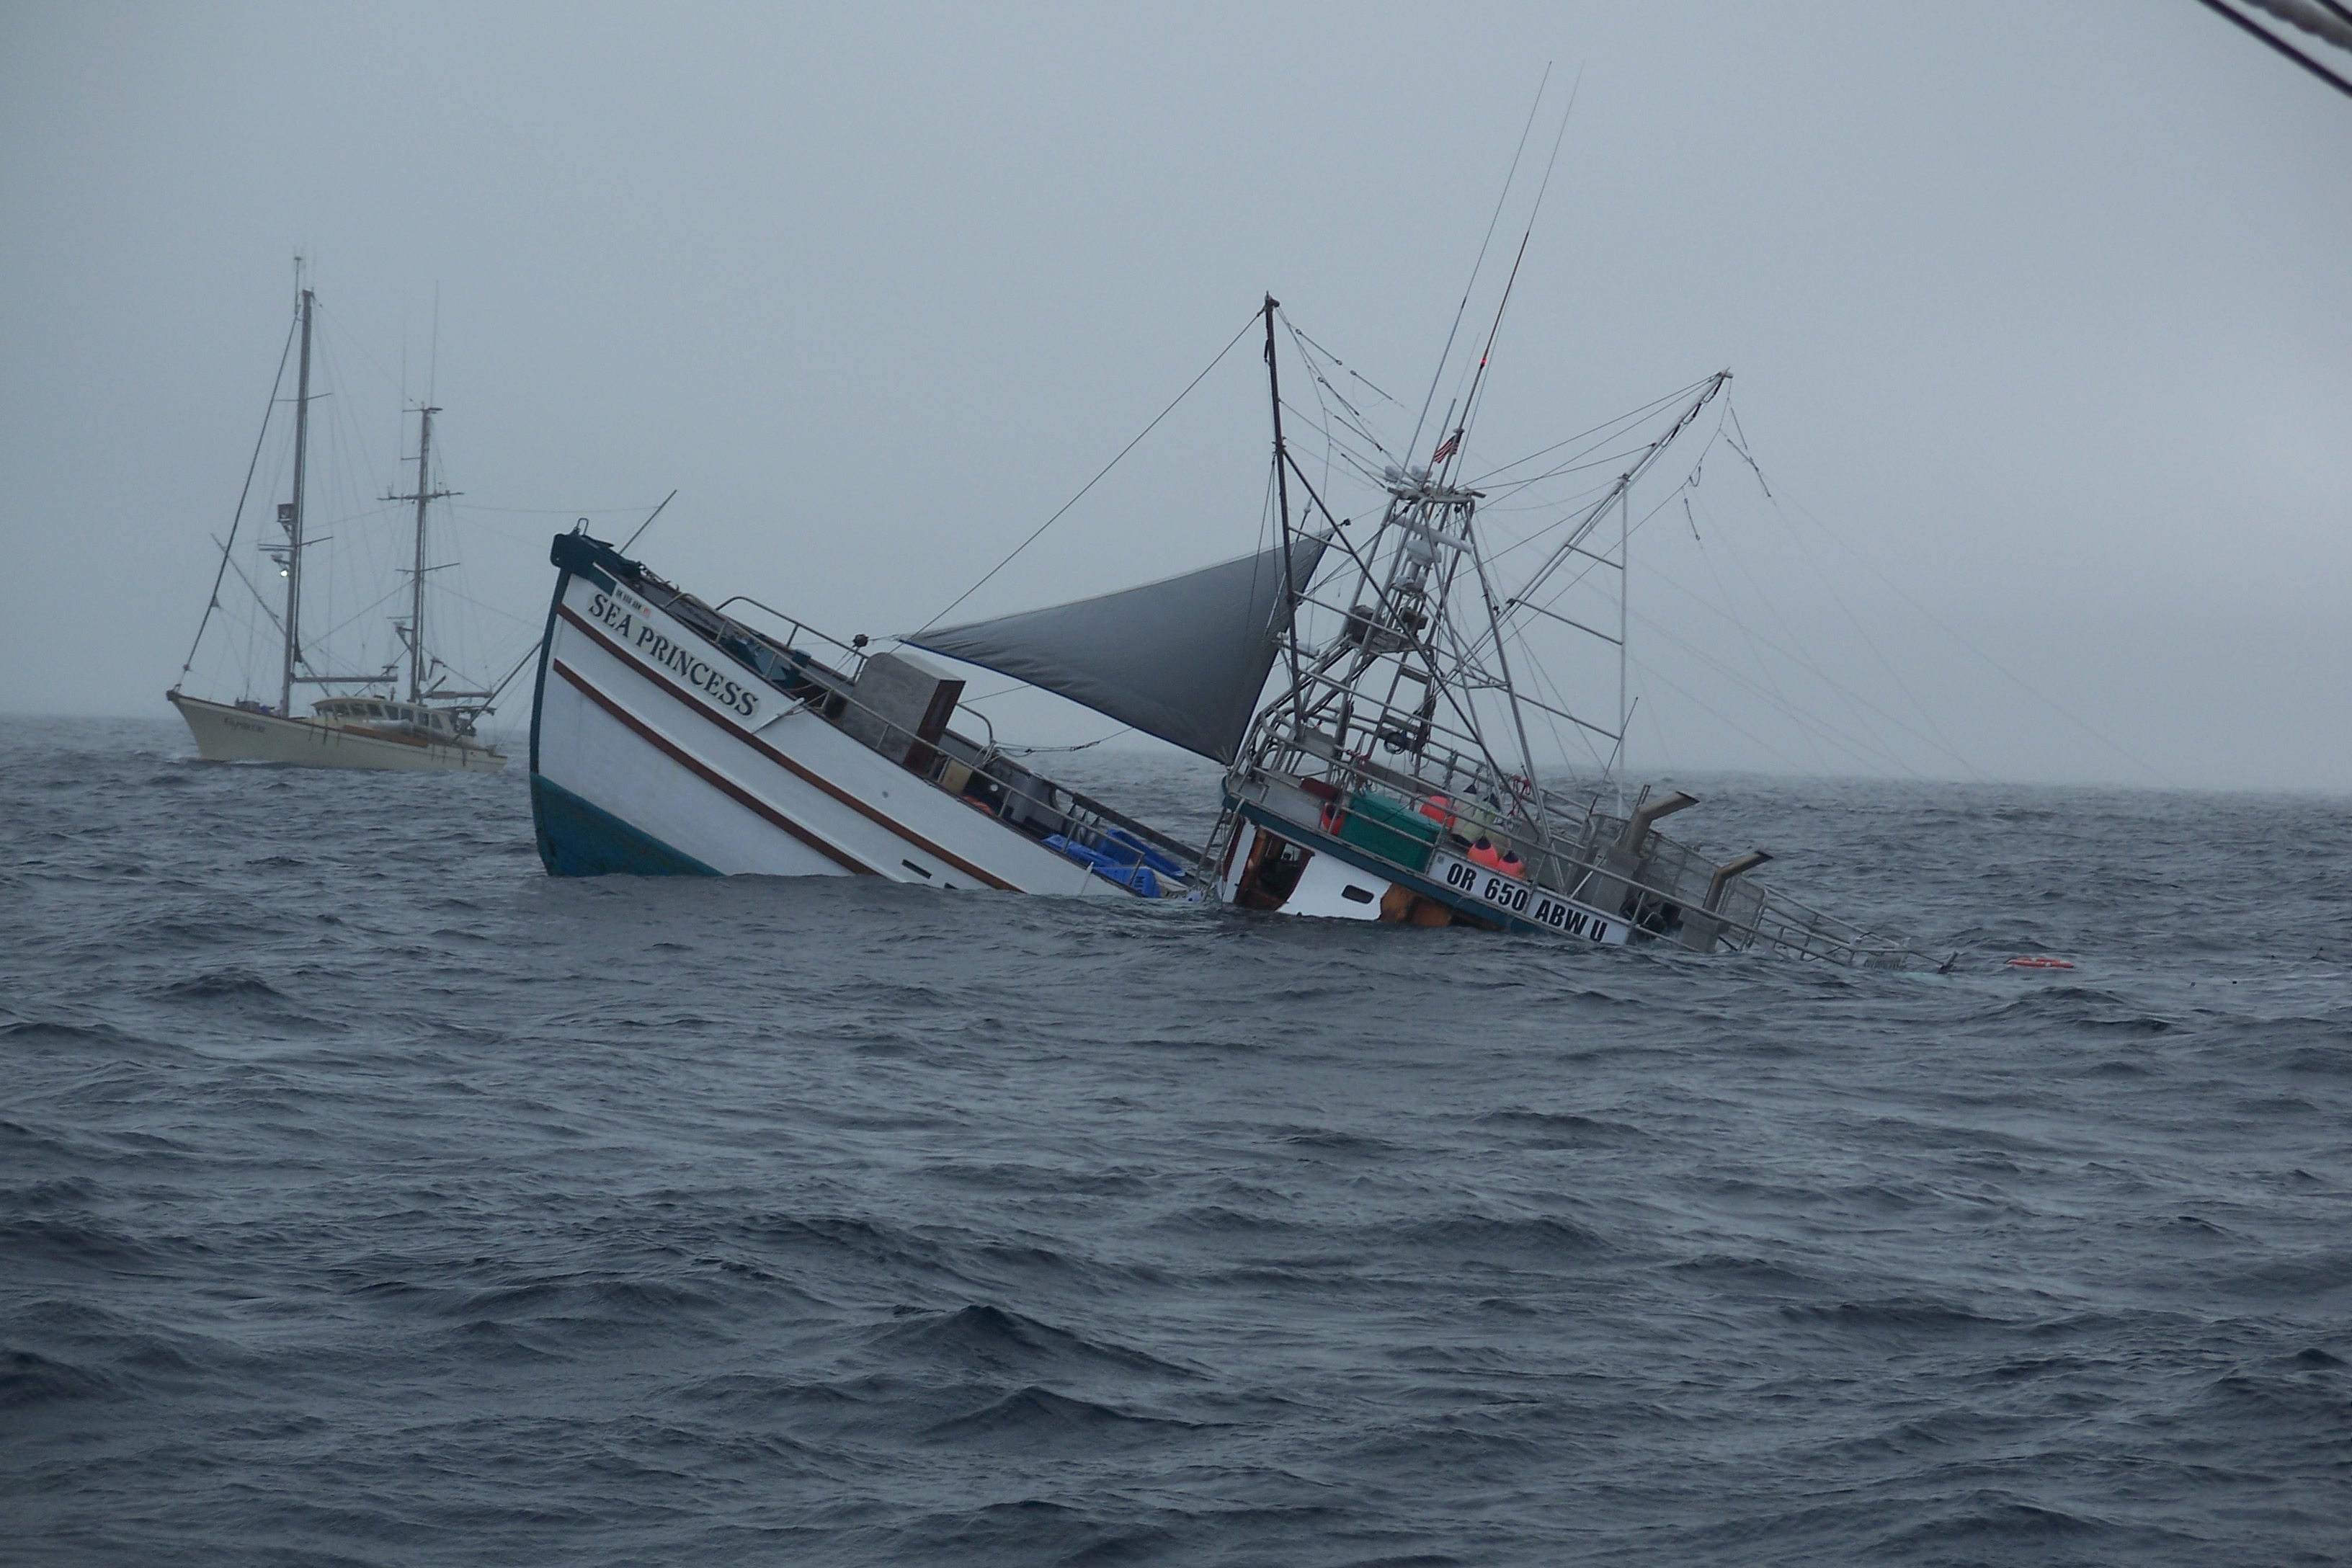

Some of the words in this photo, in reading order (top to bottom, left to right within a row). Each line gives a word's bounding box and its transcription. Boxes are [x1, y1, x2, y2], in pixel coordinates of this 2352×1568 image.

[588, 594, 632, 638] SEA
[635, 625, 759, 716] PRINCESS
[1446, 863, 1477, 891] OR
[1484, 878, 1528, 912] 650
[1533, 899, 1589, 935] ABW
